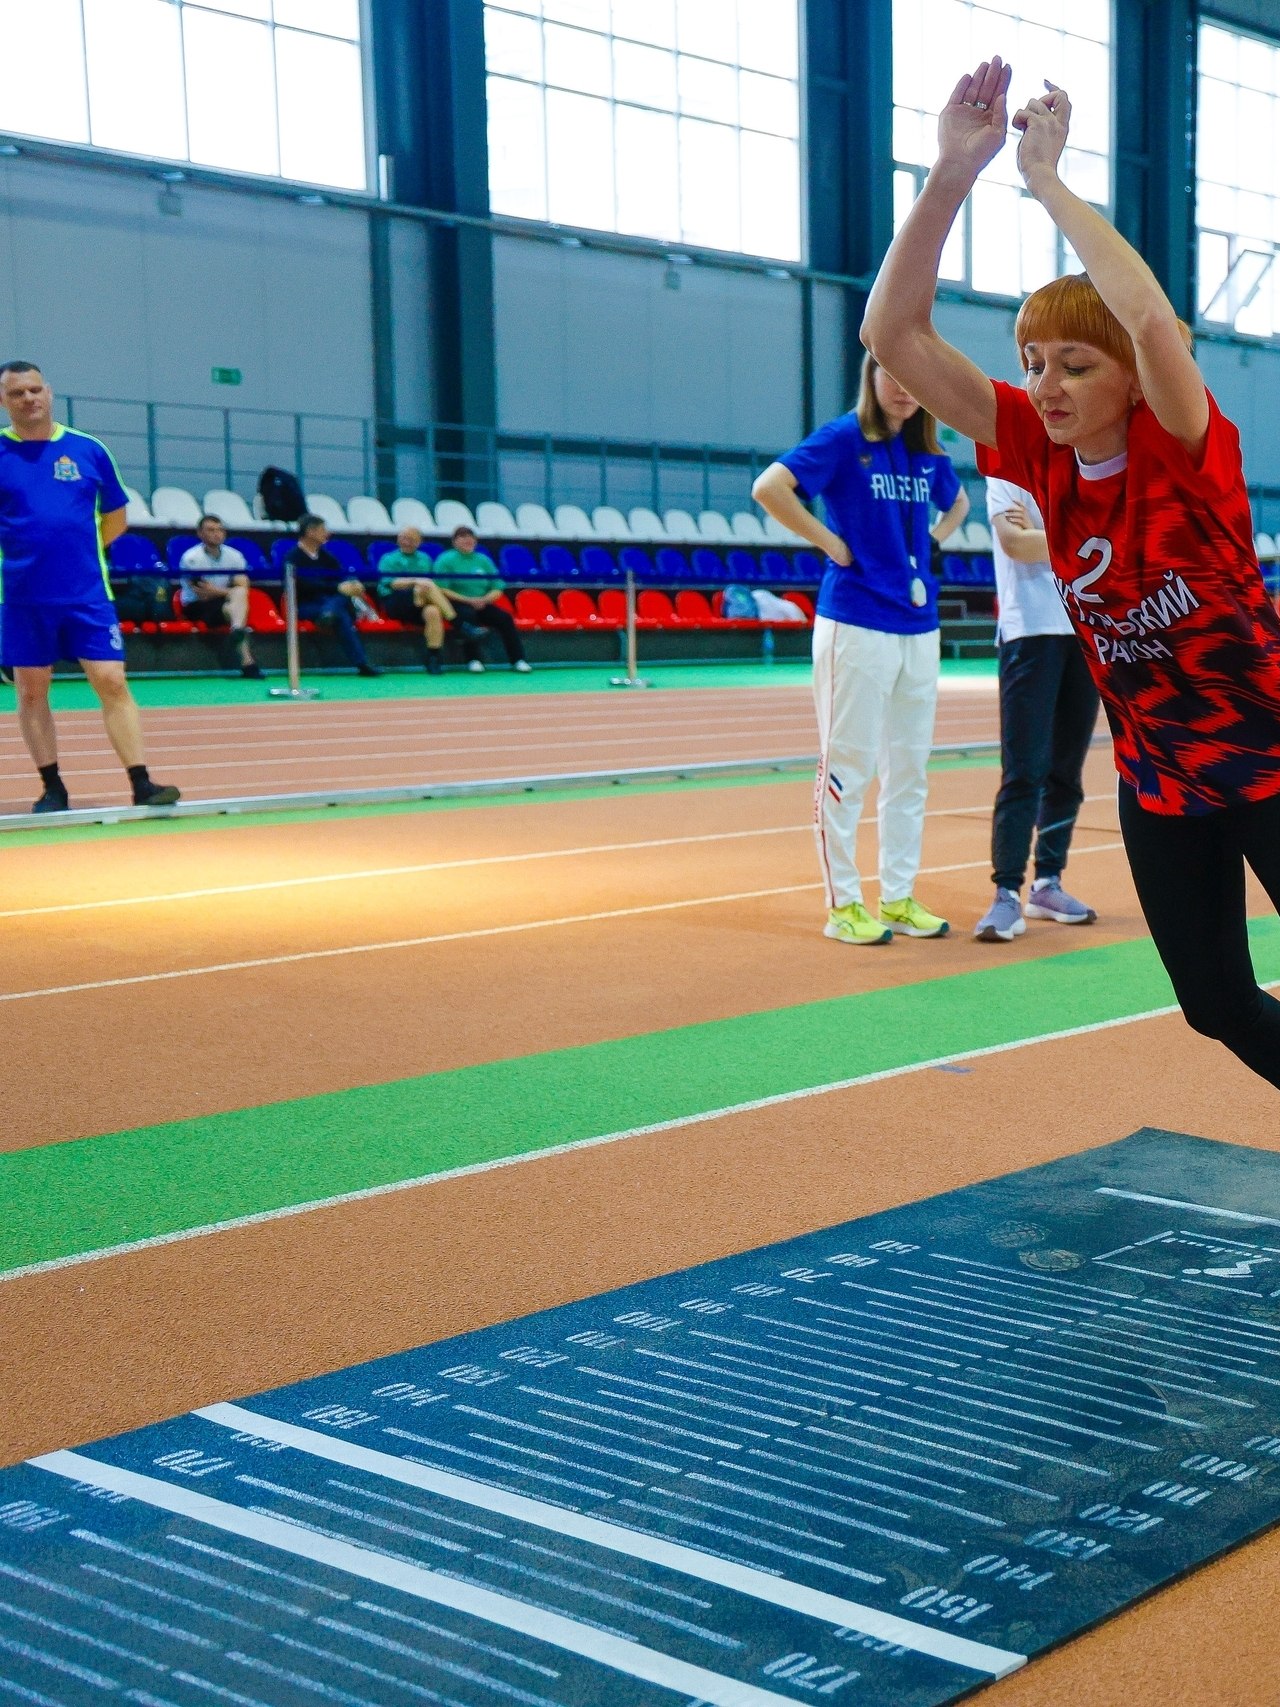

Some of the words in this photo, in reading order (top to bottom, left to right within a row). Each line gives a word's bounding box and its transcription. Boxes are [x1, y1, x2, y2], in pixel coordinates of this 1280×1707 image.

[1071, 536, 1113, 604] 2
[780, 1267, 833, 1283] 70
[679, 1298, 734, 1314] 90
[613, 1311, 682, 1332] 100
[498, 1346, 569, 1368] 120
[371, 1382, 450, 1407] 140
[301, 1404, 381, 1431] 150
[153, 1448, 234, 1478] 170
[1180, 1453, 1259, 1482] 100
[1141, 1480, 1214, 1507] 110
[1078, 1502, 1165, 1536] 120
[1023, 1528, 1112, 1561] 130
[962, 1554, 1055, 1592] 140
[899, 1585, 994, 1624] 150
[762, 1652, 861, 1695] 170
